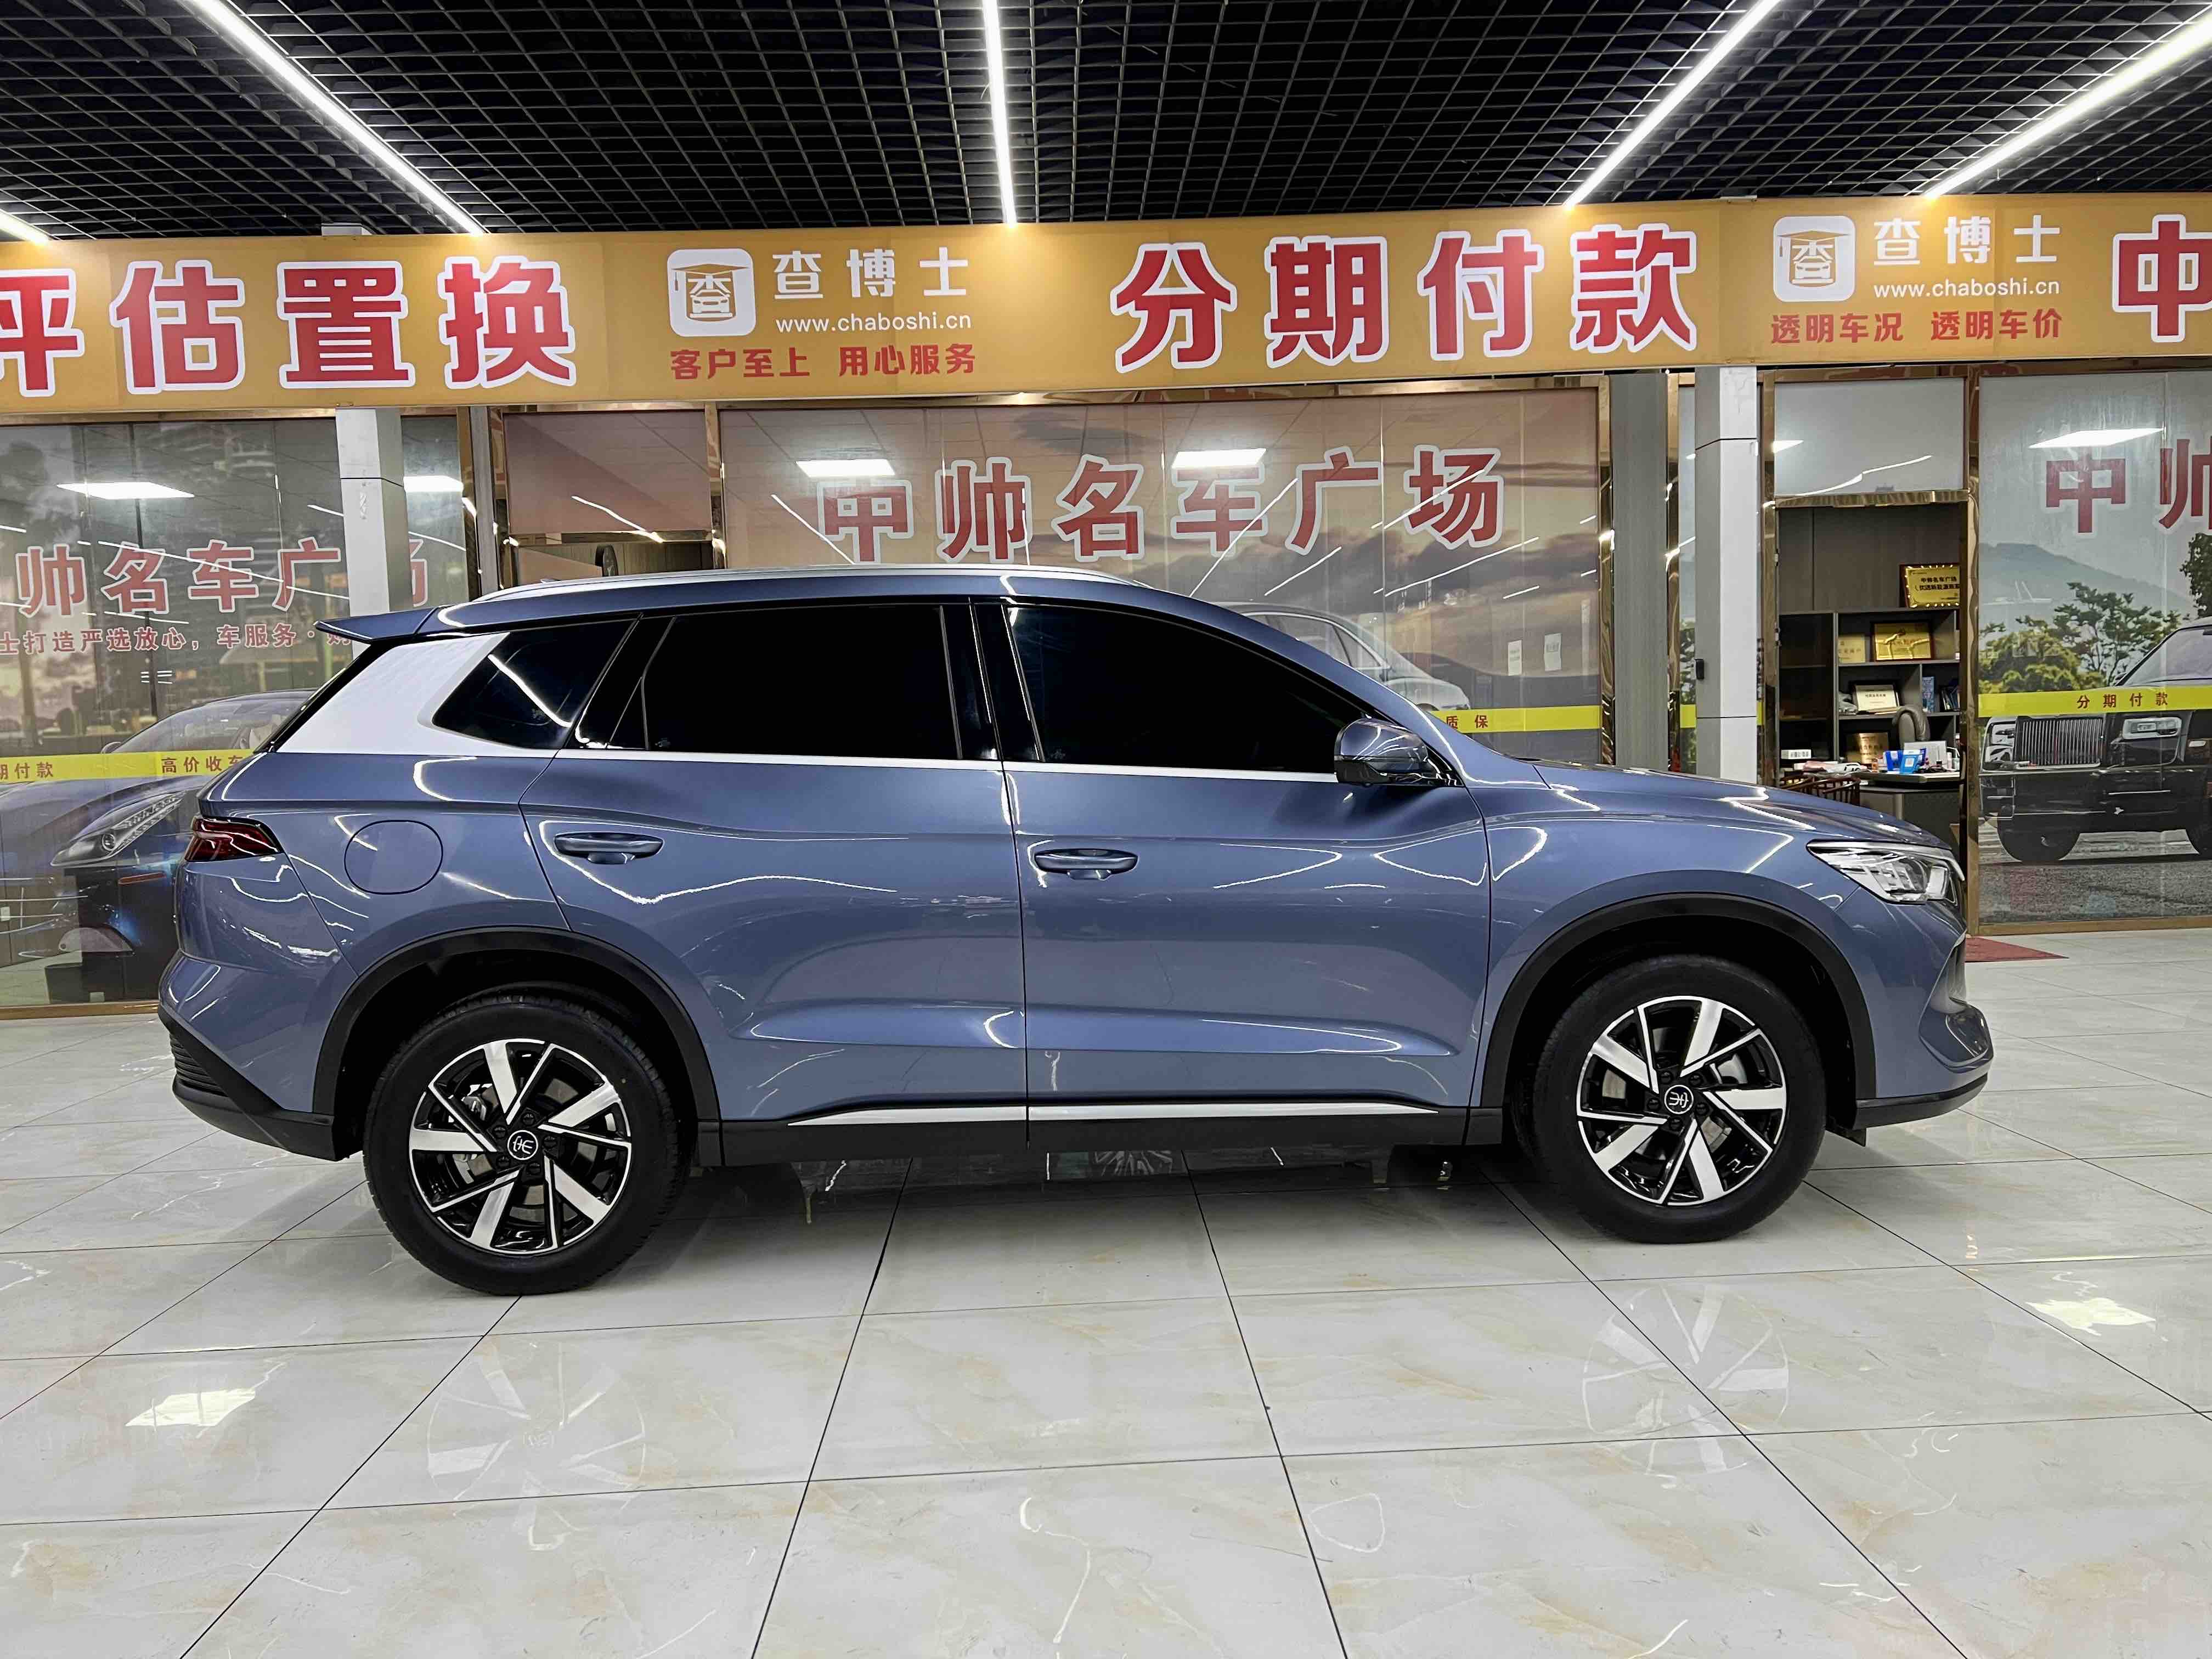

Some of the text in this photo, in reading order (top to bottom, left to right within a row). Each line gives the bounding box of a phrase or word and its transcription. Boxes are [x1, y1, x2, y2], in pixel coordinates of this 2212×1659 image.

[1874, 215, 2060, 266] 查博士
[772, 247, 968, 299] 查博士
[1874, 277, 2061, 298] www.chaboshi.cn
[2113, 215, 2212, 342] 中
[1110, 223, 1697, 373] 分期付款
[776, 312, 972, 332] www.chaboshi.cn
[1771, 308, 2062, 343] 透明车况 透明车价
[670, 343, 975, 380] 客户至上 用心服务
[817, 445, 1503, 563] 中帅名车广场
[15, 538, 428, 617] 帅名车广
[1446, 715, 1488, 729] 质保
[2076, 693, 2168, 708] 分期付款
